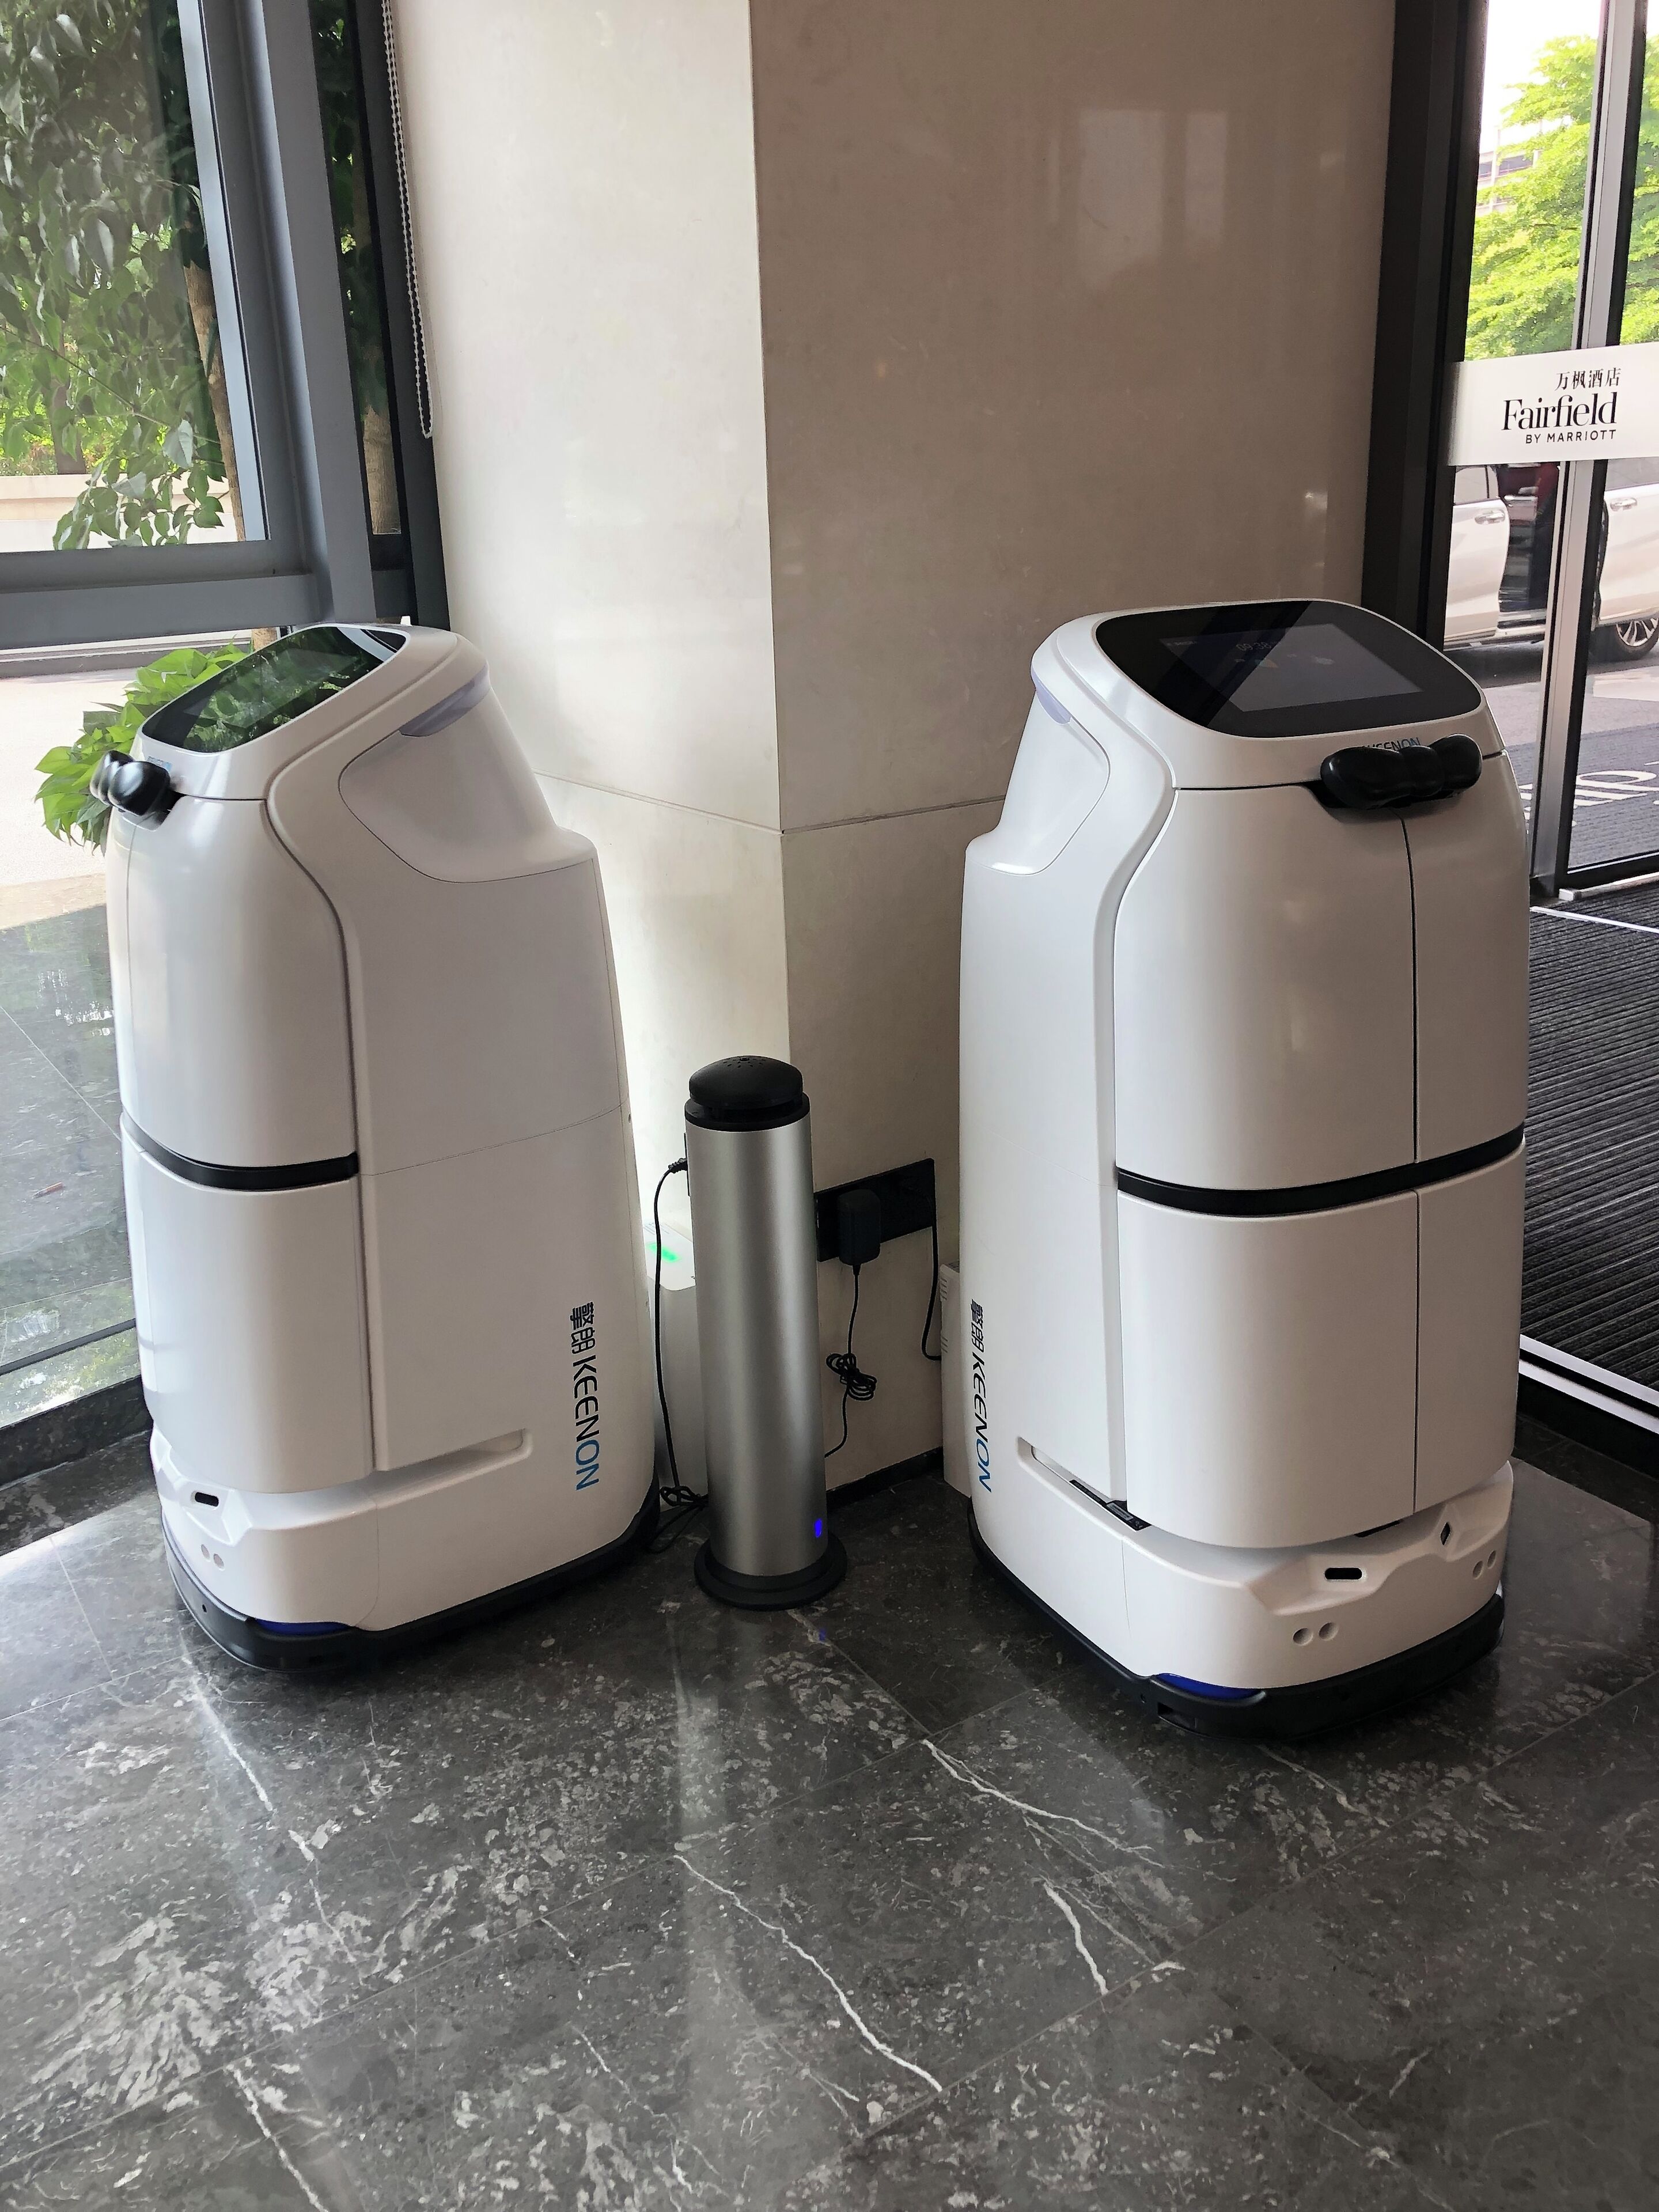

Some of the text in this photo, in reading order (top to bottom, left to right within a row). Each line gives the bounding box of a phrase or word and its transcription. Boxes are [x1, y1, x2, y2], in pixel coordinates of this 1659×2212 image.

[1555, 367, 1621, 391] 万枫酒店
[1501, 392, 1618, 431] Fairfield
[1525, 429, 1616, 444] BY MARRIOTT
[1367, 737, 1421, 751] ENON
[570, 1301, 600, 1491] 擎朗 KEENON
[971, 1298, 992, 1493] 擎朗 KEENON
